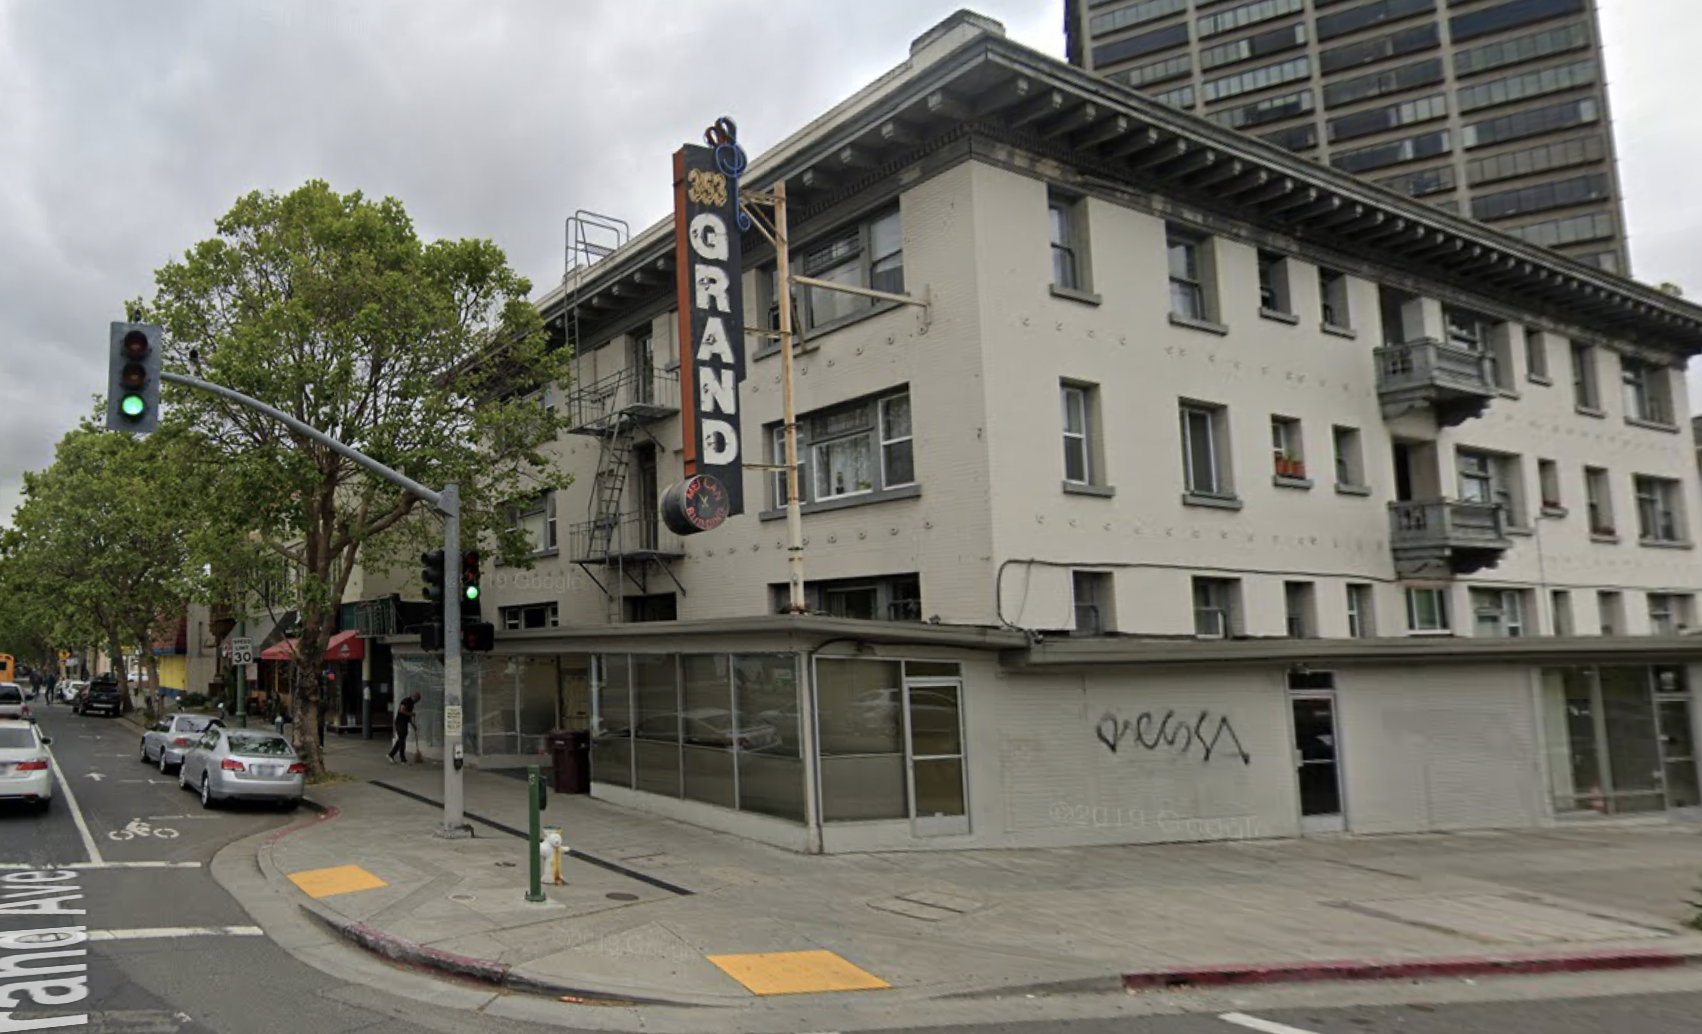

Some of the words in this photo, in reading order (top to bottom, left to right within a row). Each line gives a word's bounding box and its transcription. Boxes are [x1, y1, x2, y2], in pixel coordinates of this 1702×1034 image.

[688, 168, 728, 208] 353
[689, 212, 738, 466] GRAND
[234, 652, 251, 663] 30
